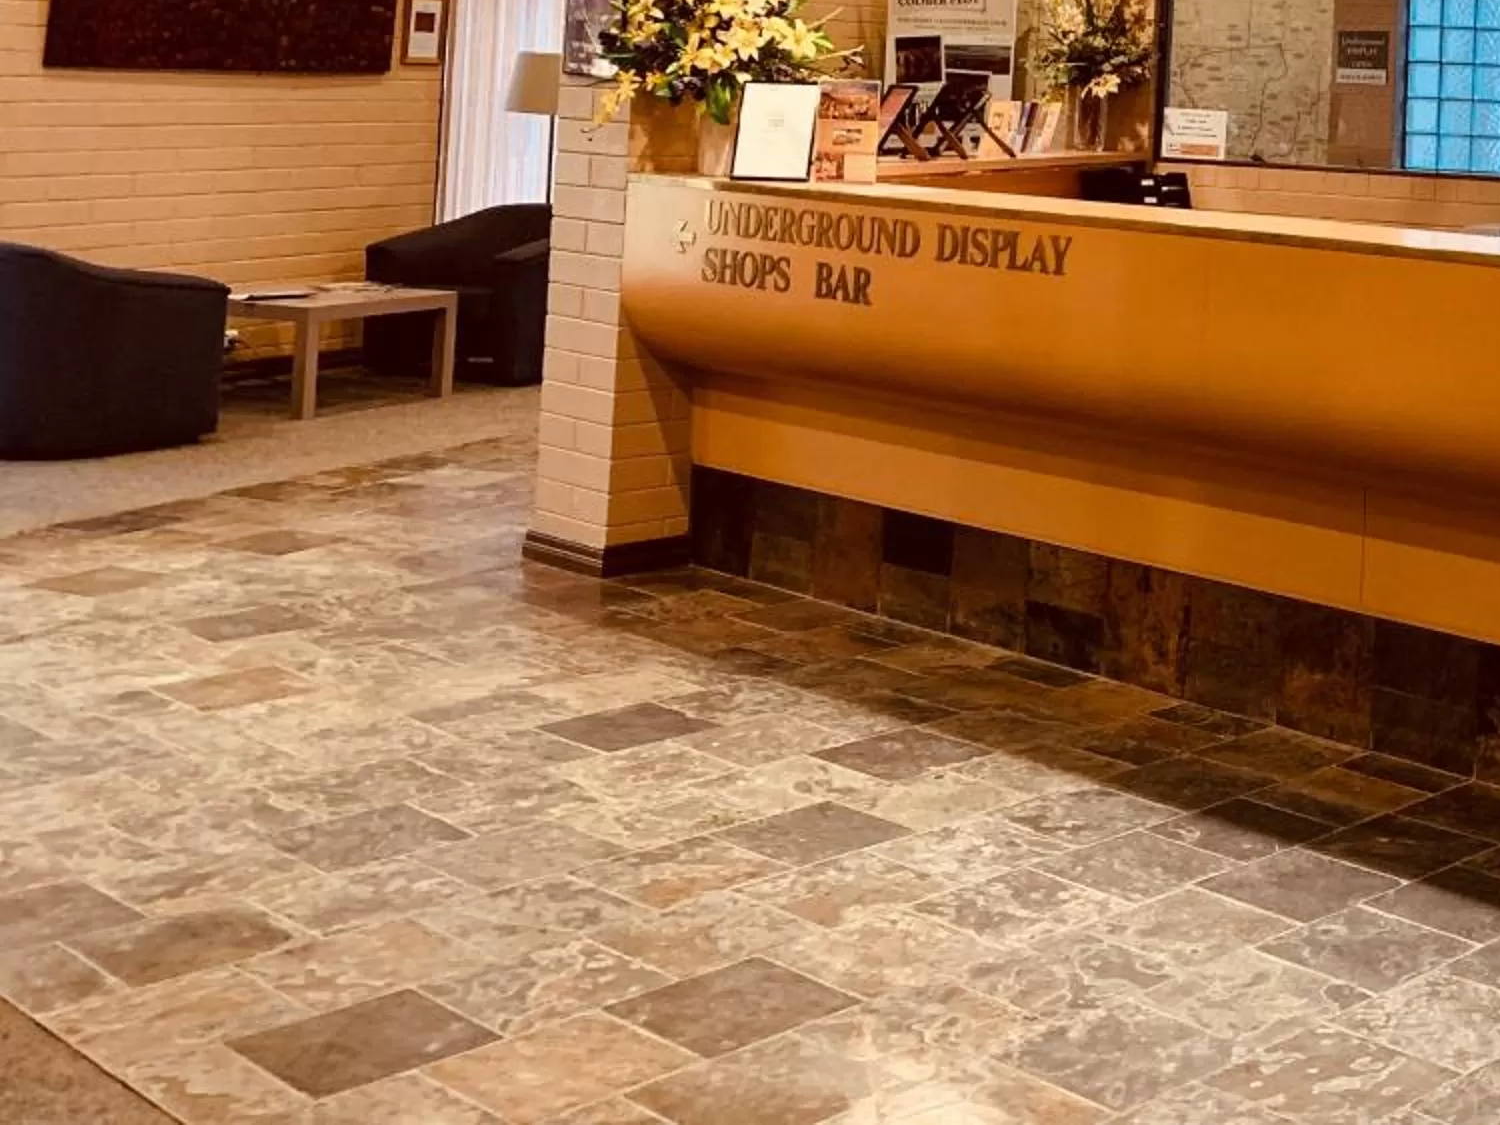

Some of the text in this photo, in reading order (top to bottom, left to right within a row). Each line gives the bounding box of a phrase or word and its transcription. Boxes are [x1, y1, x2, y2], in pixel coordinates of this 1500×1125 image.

[704, 199, 1072, 276] UNDERGROUND DISPLAY
[701, 247, 873, 306] SHOPS BAR
